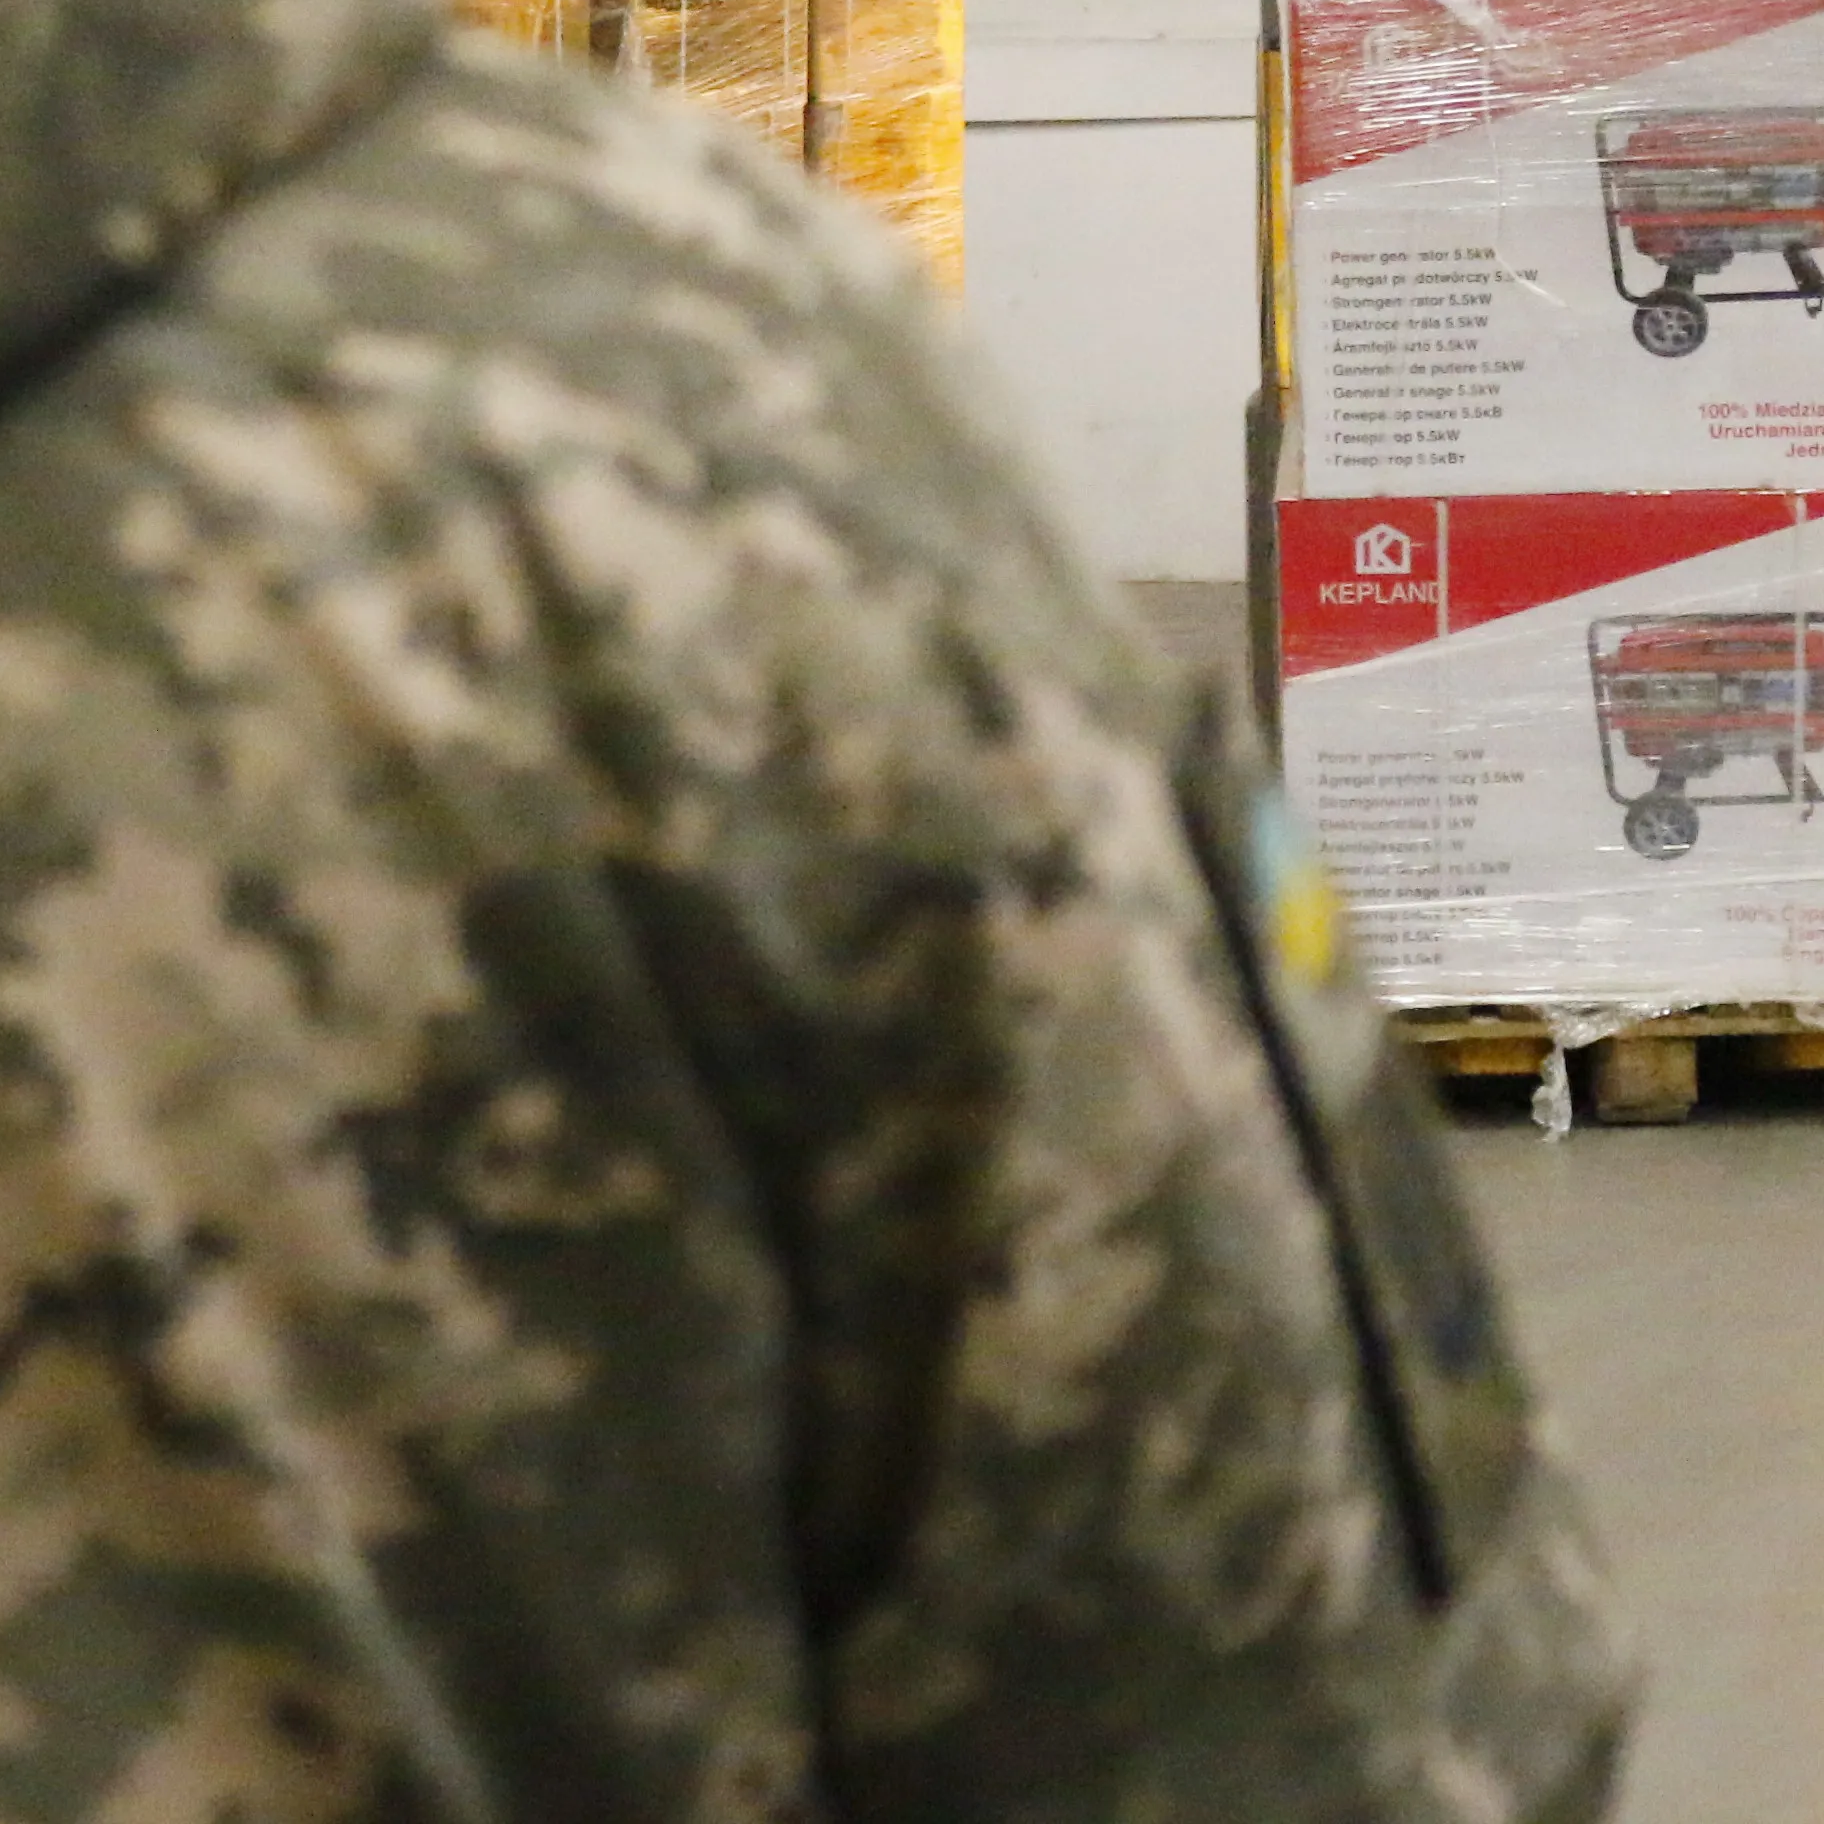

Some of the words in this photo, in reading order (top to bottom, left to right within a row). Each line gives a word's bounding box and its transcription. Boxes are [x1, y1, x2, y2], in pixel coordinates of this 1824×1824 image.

[1332, 297, 1444, 312] Stromgenrator
[1334, 408, 1412, 423] Генераор
[1698, 403, 1749, 419] 100%
[1334, 431, 1413, 446] Генераор
[1334, 454, 1413, 468] Генертор
